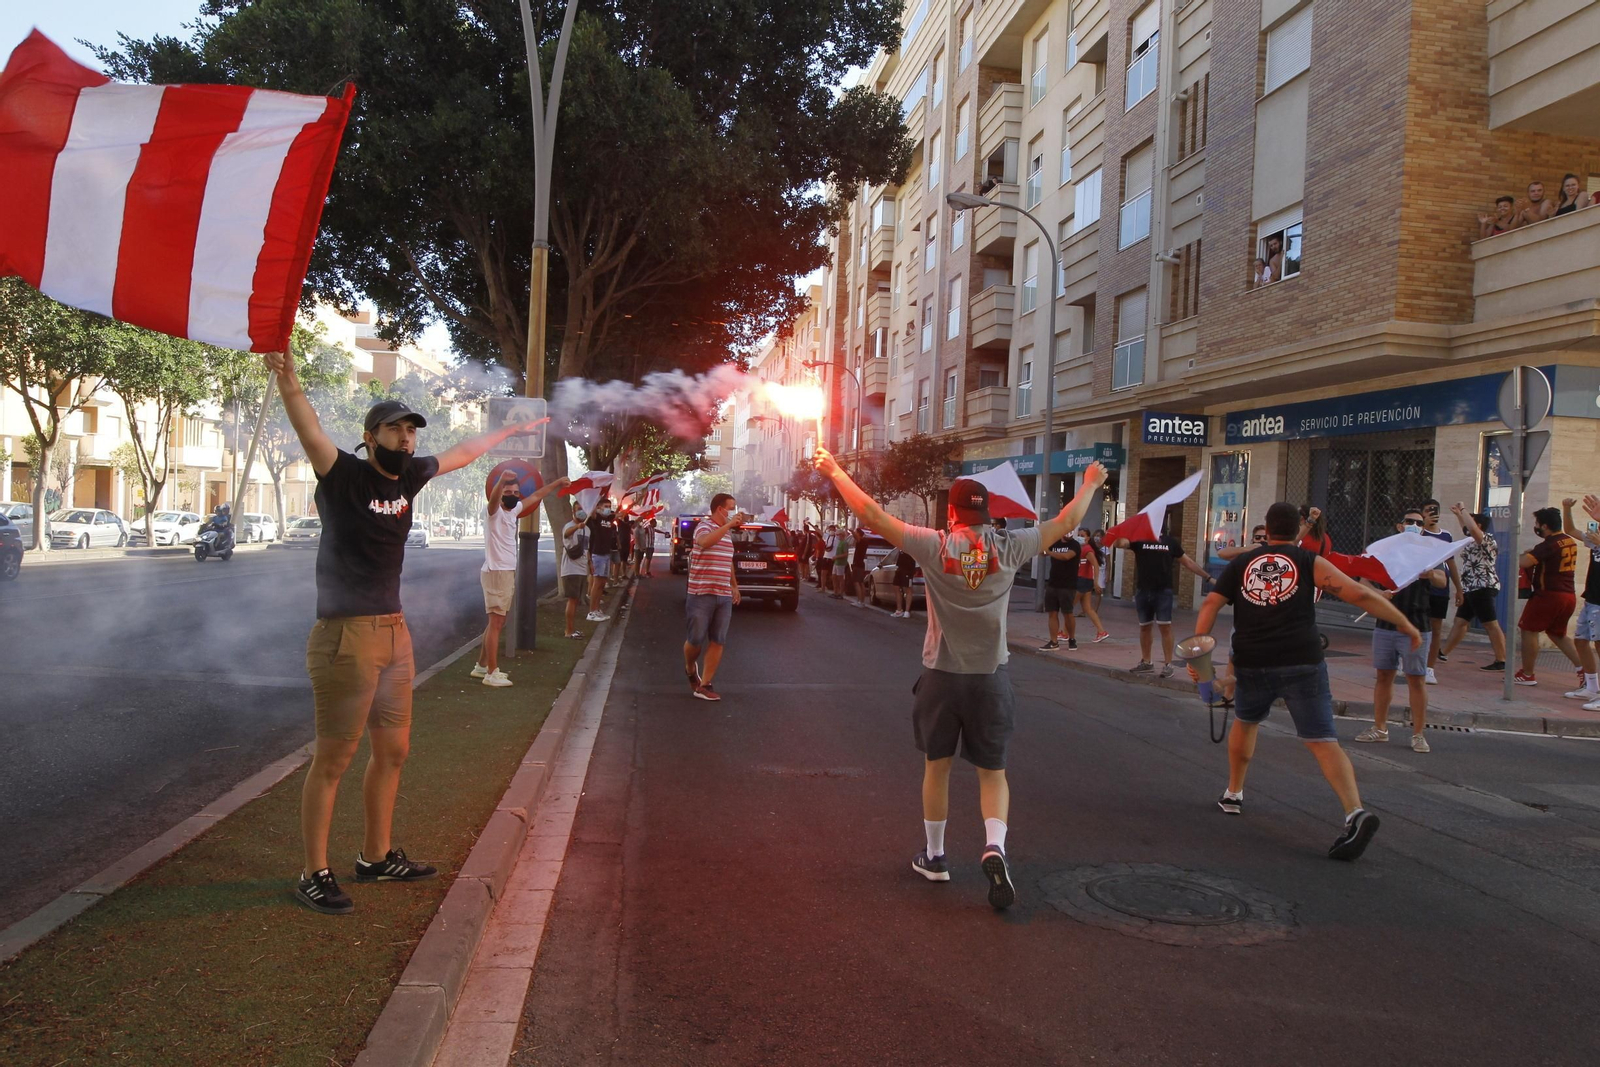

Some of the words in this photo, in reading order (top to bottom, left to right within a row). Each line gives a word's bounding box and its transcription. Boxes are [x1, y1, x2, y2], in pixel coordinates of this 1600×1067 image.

[1148, 416, 1205, 436] antea
[1242, 413, 1284, 437] antea
[1300, 415, 1339, 431] SERVICIO
[1342, 413, 1354, 427] DE
[1357, 404, 1421, 425] PREVENCIÓN
[1147, 435, 1205, 444] PREVENCIÓN
[1075, 454, 1094, 468] cajamar
[1483, 505, 1512, 519] ante
